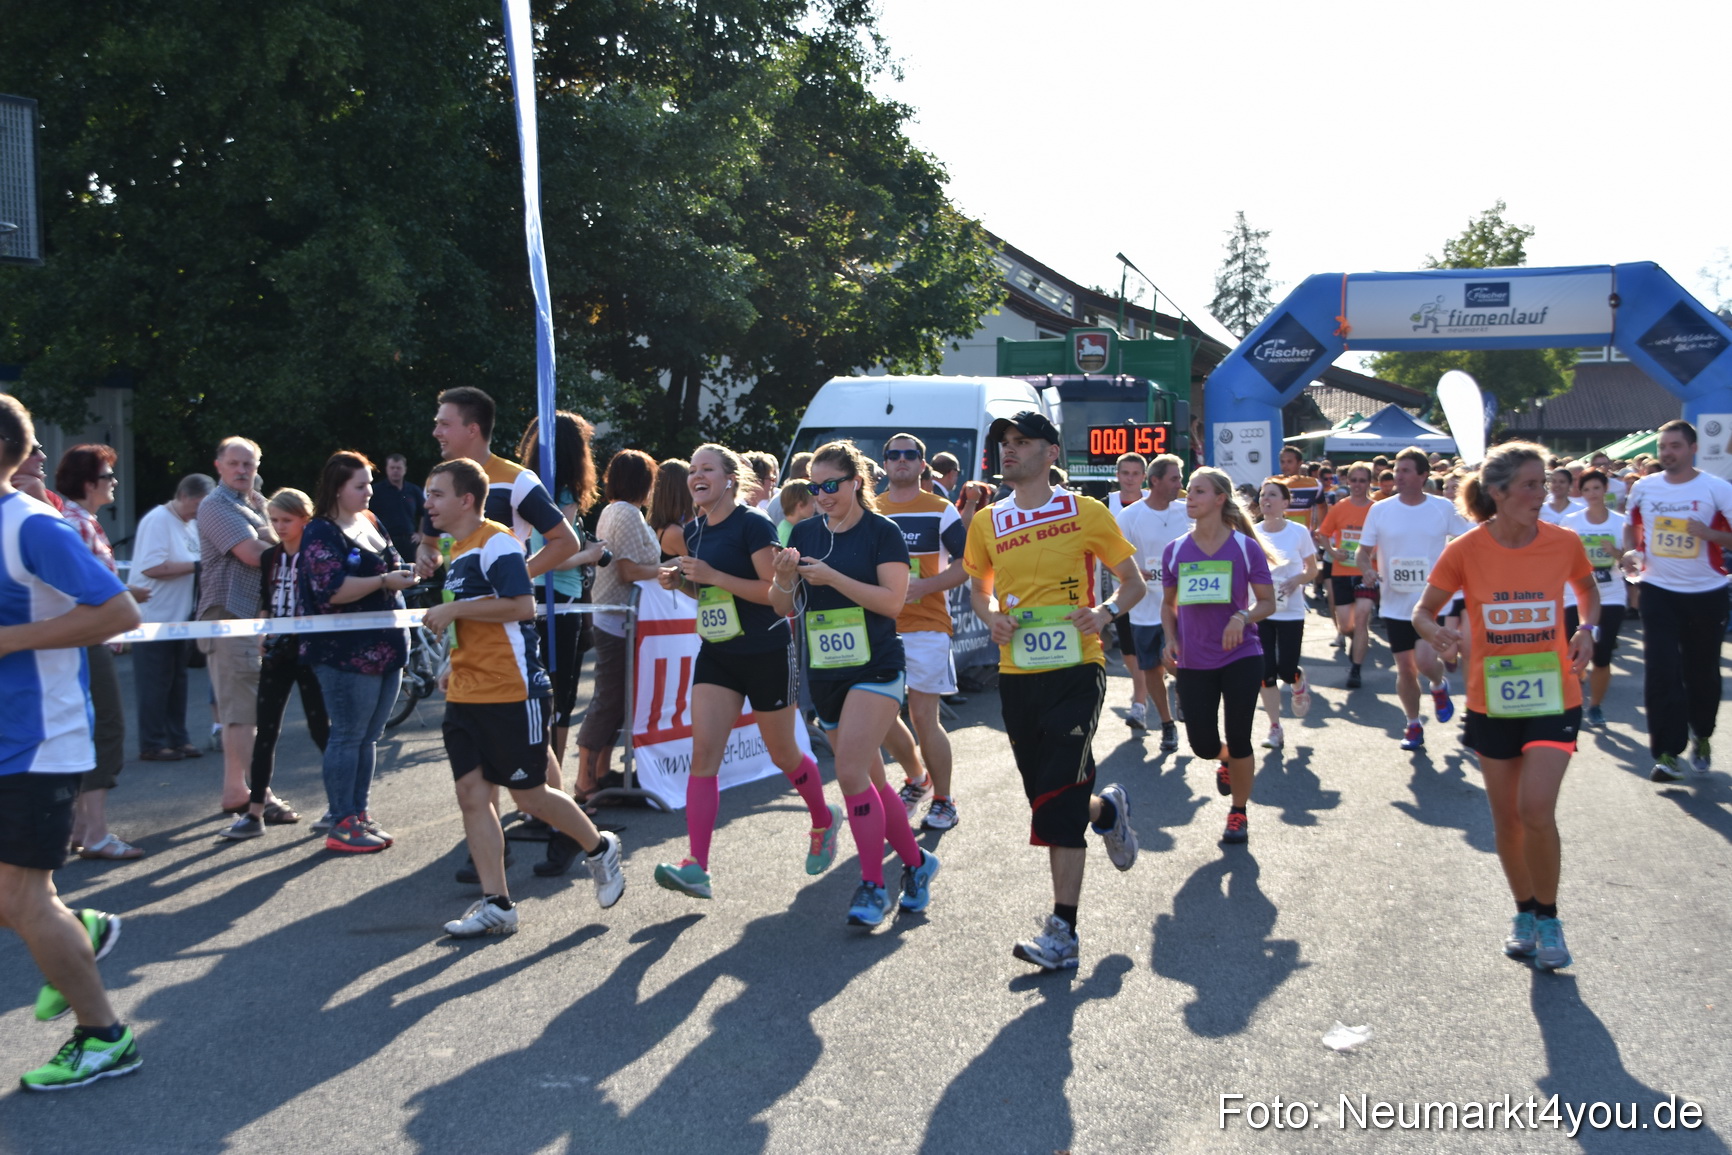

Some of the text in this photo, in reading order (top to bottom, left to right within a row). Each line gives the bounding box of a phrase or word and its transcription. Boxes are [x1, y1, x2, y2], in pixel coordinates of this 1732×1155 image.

[1448, 306, 1548, 327] firmenlauf
[1263, 347, 1315, 358] Fischer
[996, 521, 1081, 554] MAX BÖGL
[1656, 533, 1694, 549] 1515
[1394, 569, 1425, 581] 8911
[1188, 577, 1220, 592] 294
[1493, 590, 1544, 601] 30 Jahre
[701, 608, 727, 628] 859
[1488, 607, 1551, 625] OBI
[819, 632, 855, 652] 860
[1023, 630, 1067, 652] 902
[1486, 629, 1556, 644] Neumarkt
[1500, 678, 1544, 700] 621
